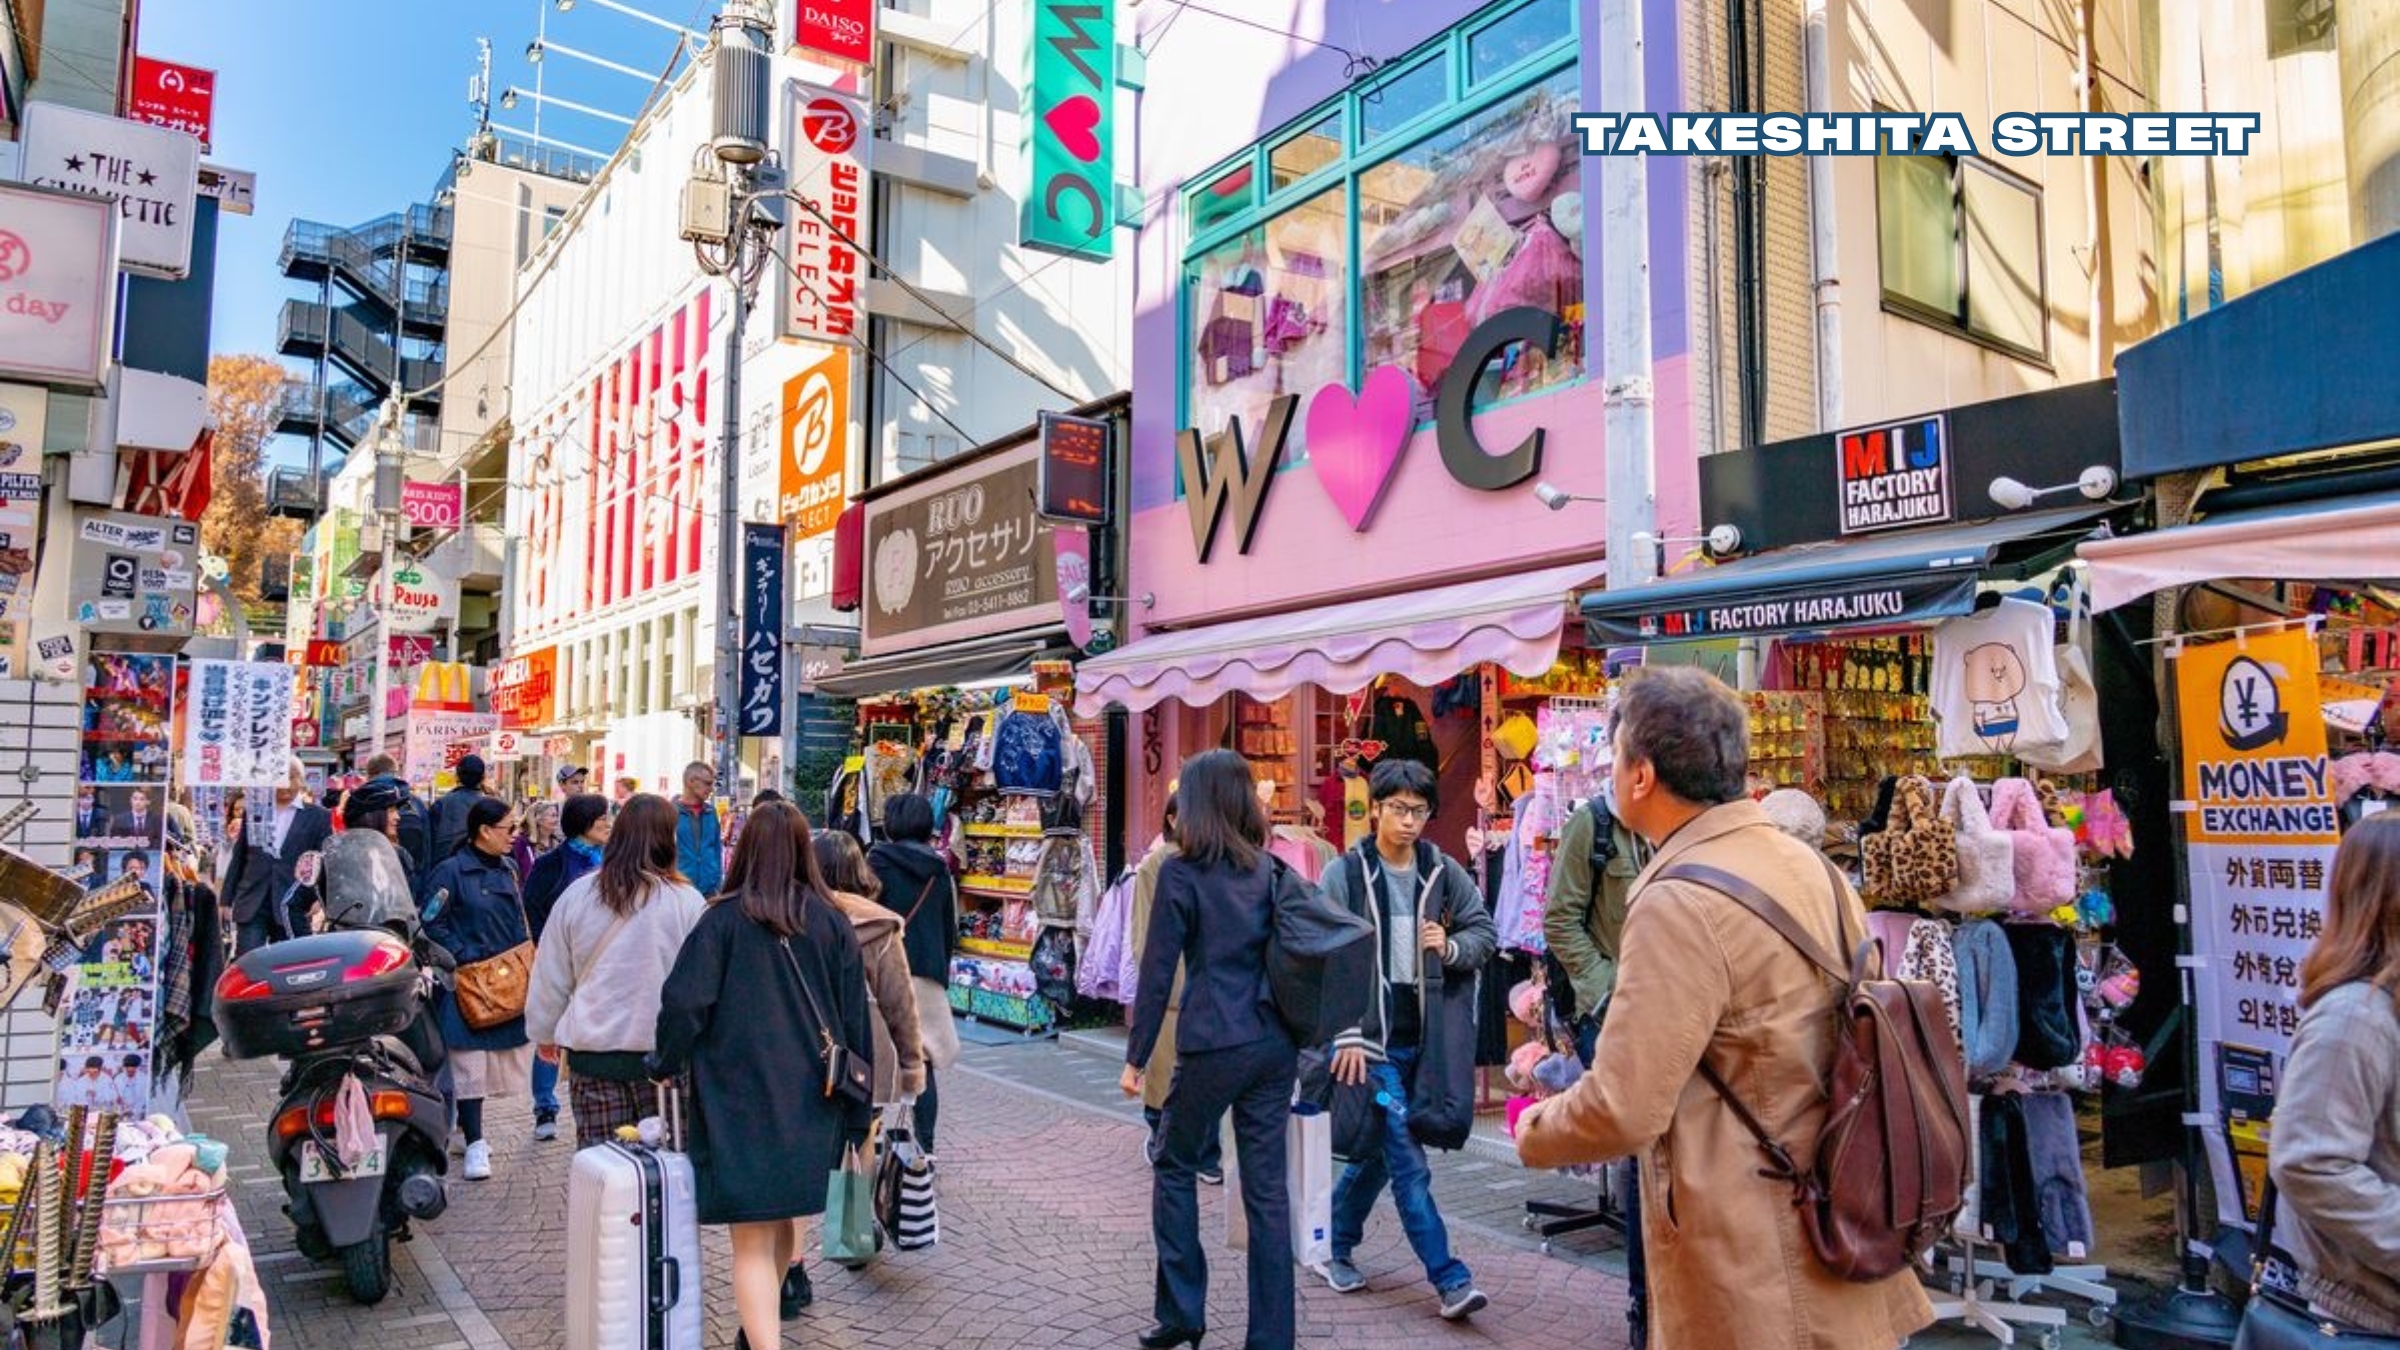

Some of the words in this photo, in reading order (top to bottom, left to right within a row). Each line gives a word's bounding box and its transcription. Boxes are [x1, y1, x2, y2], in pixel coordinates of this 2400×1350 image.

[804, 7, 864, 34] DAISO
[90, 152, 133, 187] THE
[796, 199, 821, 331] SELECT
[1844, 421, 1938, 479] MIJ
[782, 472, 841, 517] ビックカメラ
[1846, 467, 1940, 505] FACTORY
[407, 501, 452, 524] 300
[796, 505, 830, 534] ELECT
[927, 484, 985, 536] RUO
[1847, 494, 1941, 528] HARAJUKU
[85, 521, 124, 537] ALTER
[924, 512, 1056, 580] アクセサリー
[755, 556, 775, 625] ギャラリー
[974, 565, 1031, 590] accessory
[1711, 603, 1791, 631] FACTORY
[1795, 591, 1903, 622] HARAJUKU
[743, 630, 779, 734] ハセガワ
[415, 724, 458, 736] PARIS
[2199, 757, 2327, 800] MONEY
[2202, 804, 2336, 834] EXCHANGE
[2226, 857, 2325, 890] 外貨両替
